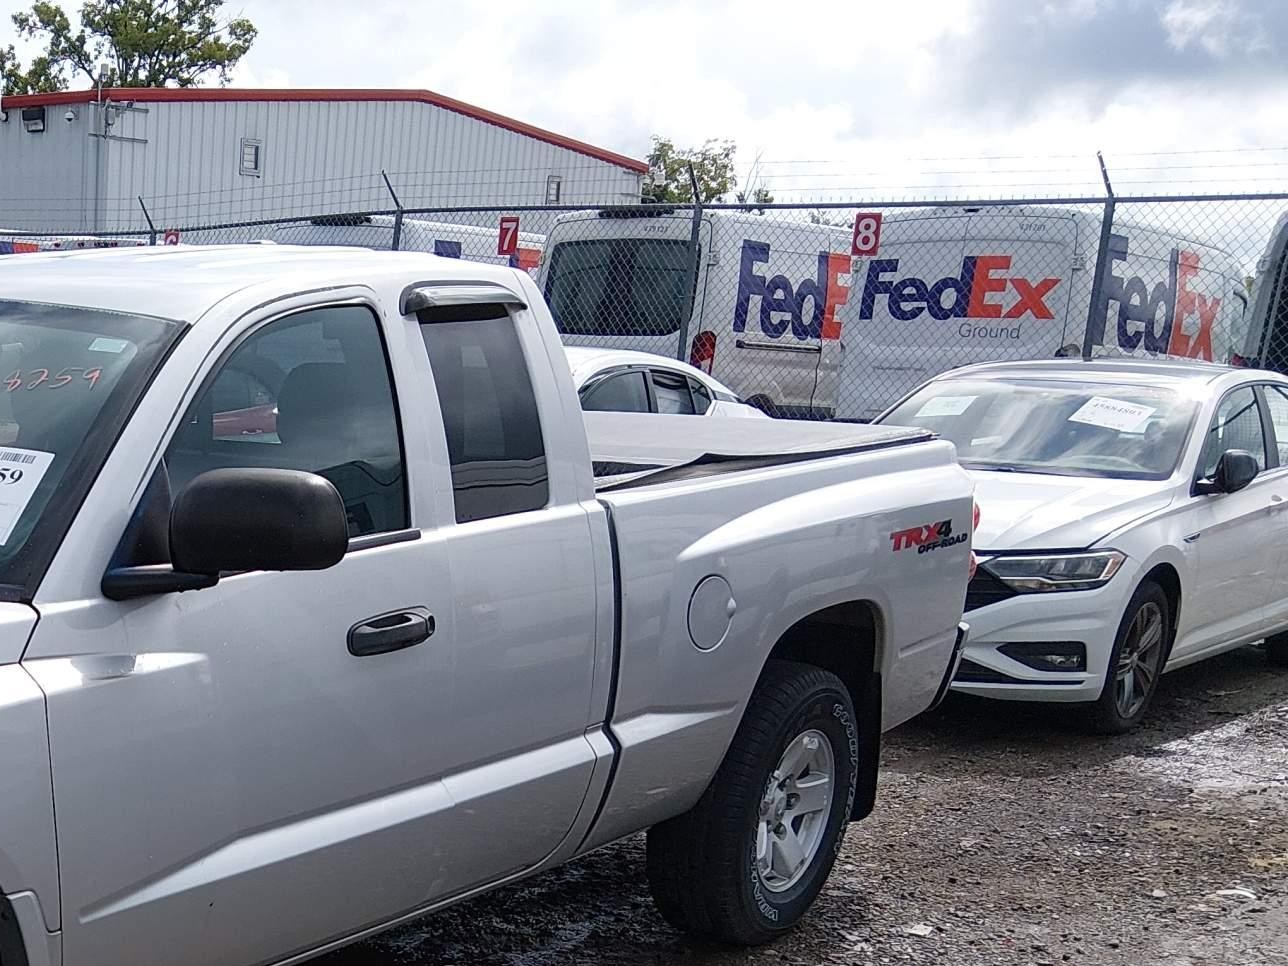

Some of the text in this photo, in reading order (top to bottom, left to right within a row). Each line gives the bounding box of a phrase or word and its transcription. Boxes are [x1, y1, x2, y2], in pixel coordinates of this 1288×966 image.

[501, 222, 518, 251] 7
[855, 218, 877, 251] 8
[733, 239, 851, 340] FedE
[859, 256, 1062, 320] FedEx
[958, 322, 1022, 339] Ground
[890, 519, 952, 551] TRX4
[918, 533, 968, 554] OFF-ROAD
